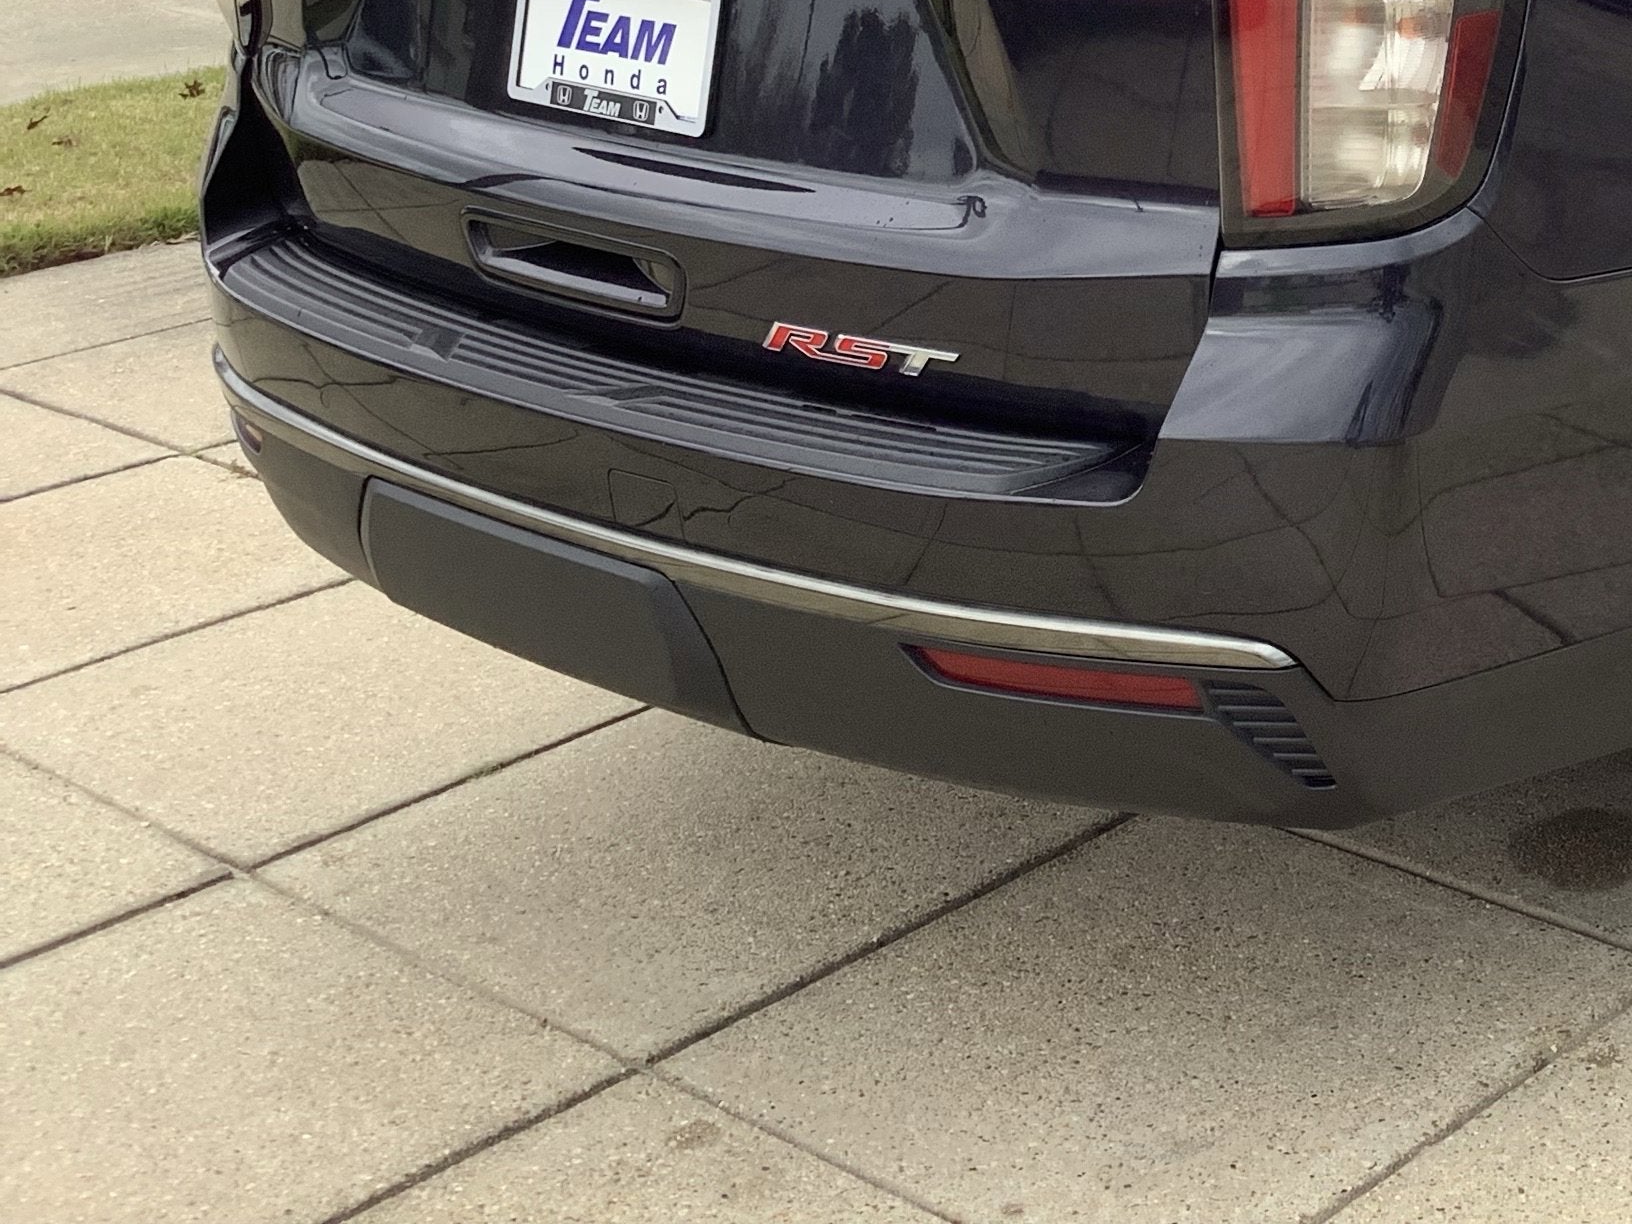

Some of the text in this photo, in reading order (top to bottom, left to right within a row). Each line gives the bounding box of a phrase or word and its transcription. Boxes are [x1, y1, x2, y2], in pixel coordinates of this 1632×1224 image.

[552, 53, 667, 95] Honda
[583, 88, 621, 117] TEAM
[761, 321, 960, 377] RST
